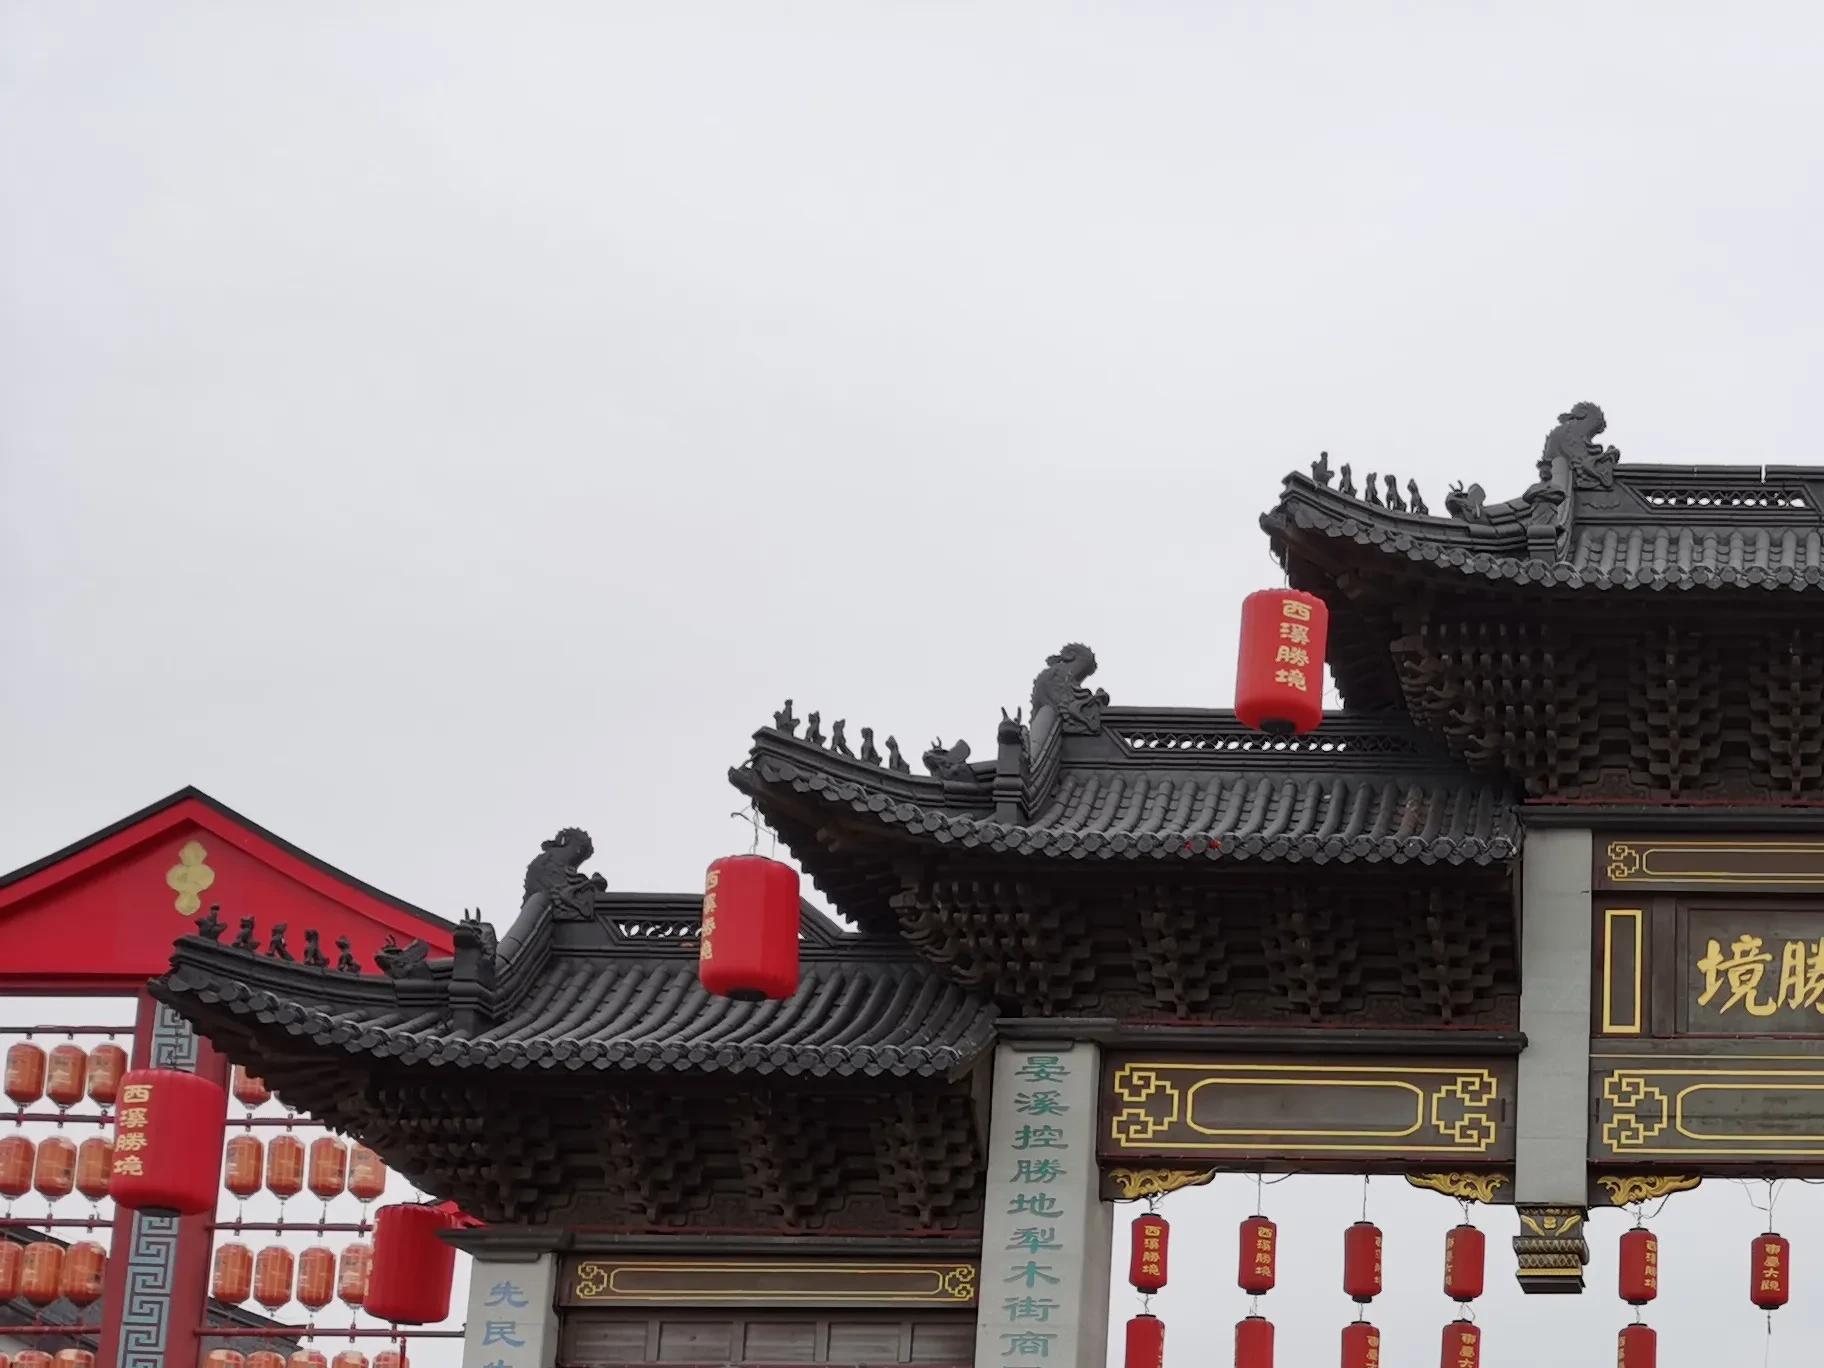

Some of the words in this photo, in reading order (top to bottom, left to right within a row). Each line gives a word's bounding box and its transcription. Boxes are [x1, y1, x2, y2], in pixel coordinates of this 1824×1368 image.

[1275, 599, 1312, 692] 西溪勝境
[113, 1084, 154, 1176] 西溪勝境
